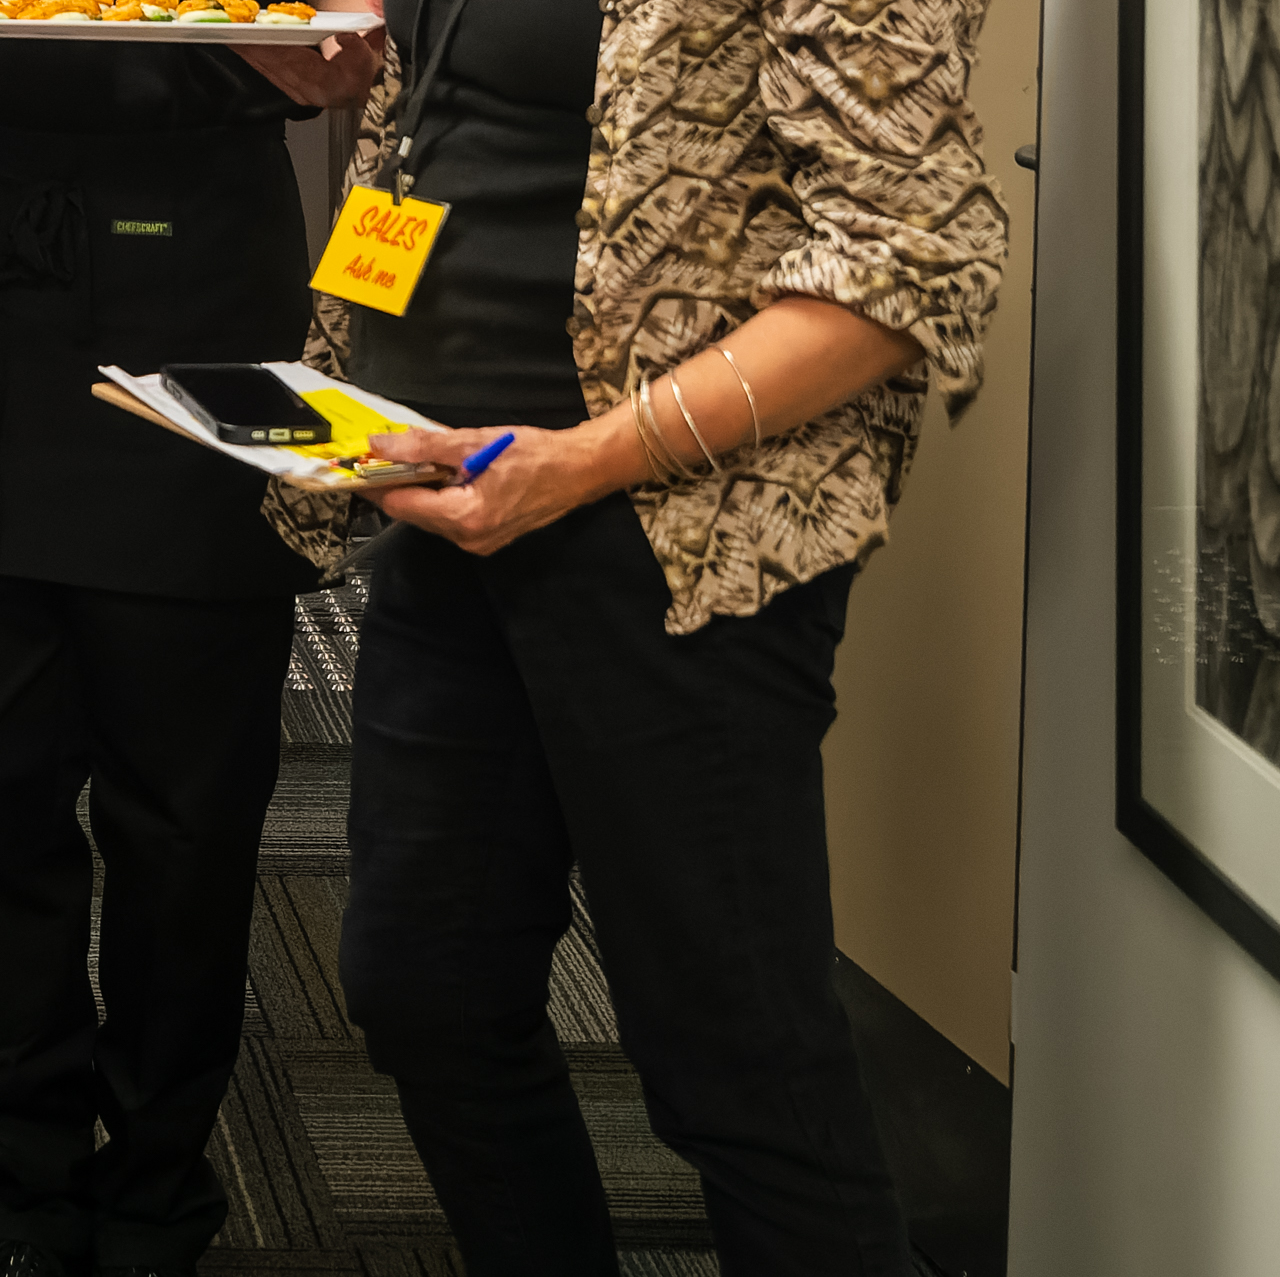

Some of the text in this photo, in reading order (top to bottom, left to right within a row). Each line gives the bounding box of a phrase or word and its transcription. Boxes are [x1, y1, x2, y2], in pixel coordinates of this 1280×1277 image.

[352, 204, 428, 252] SALES
[343, 254, 397, 290] Ask me
